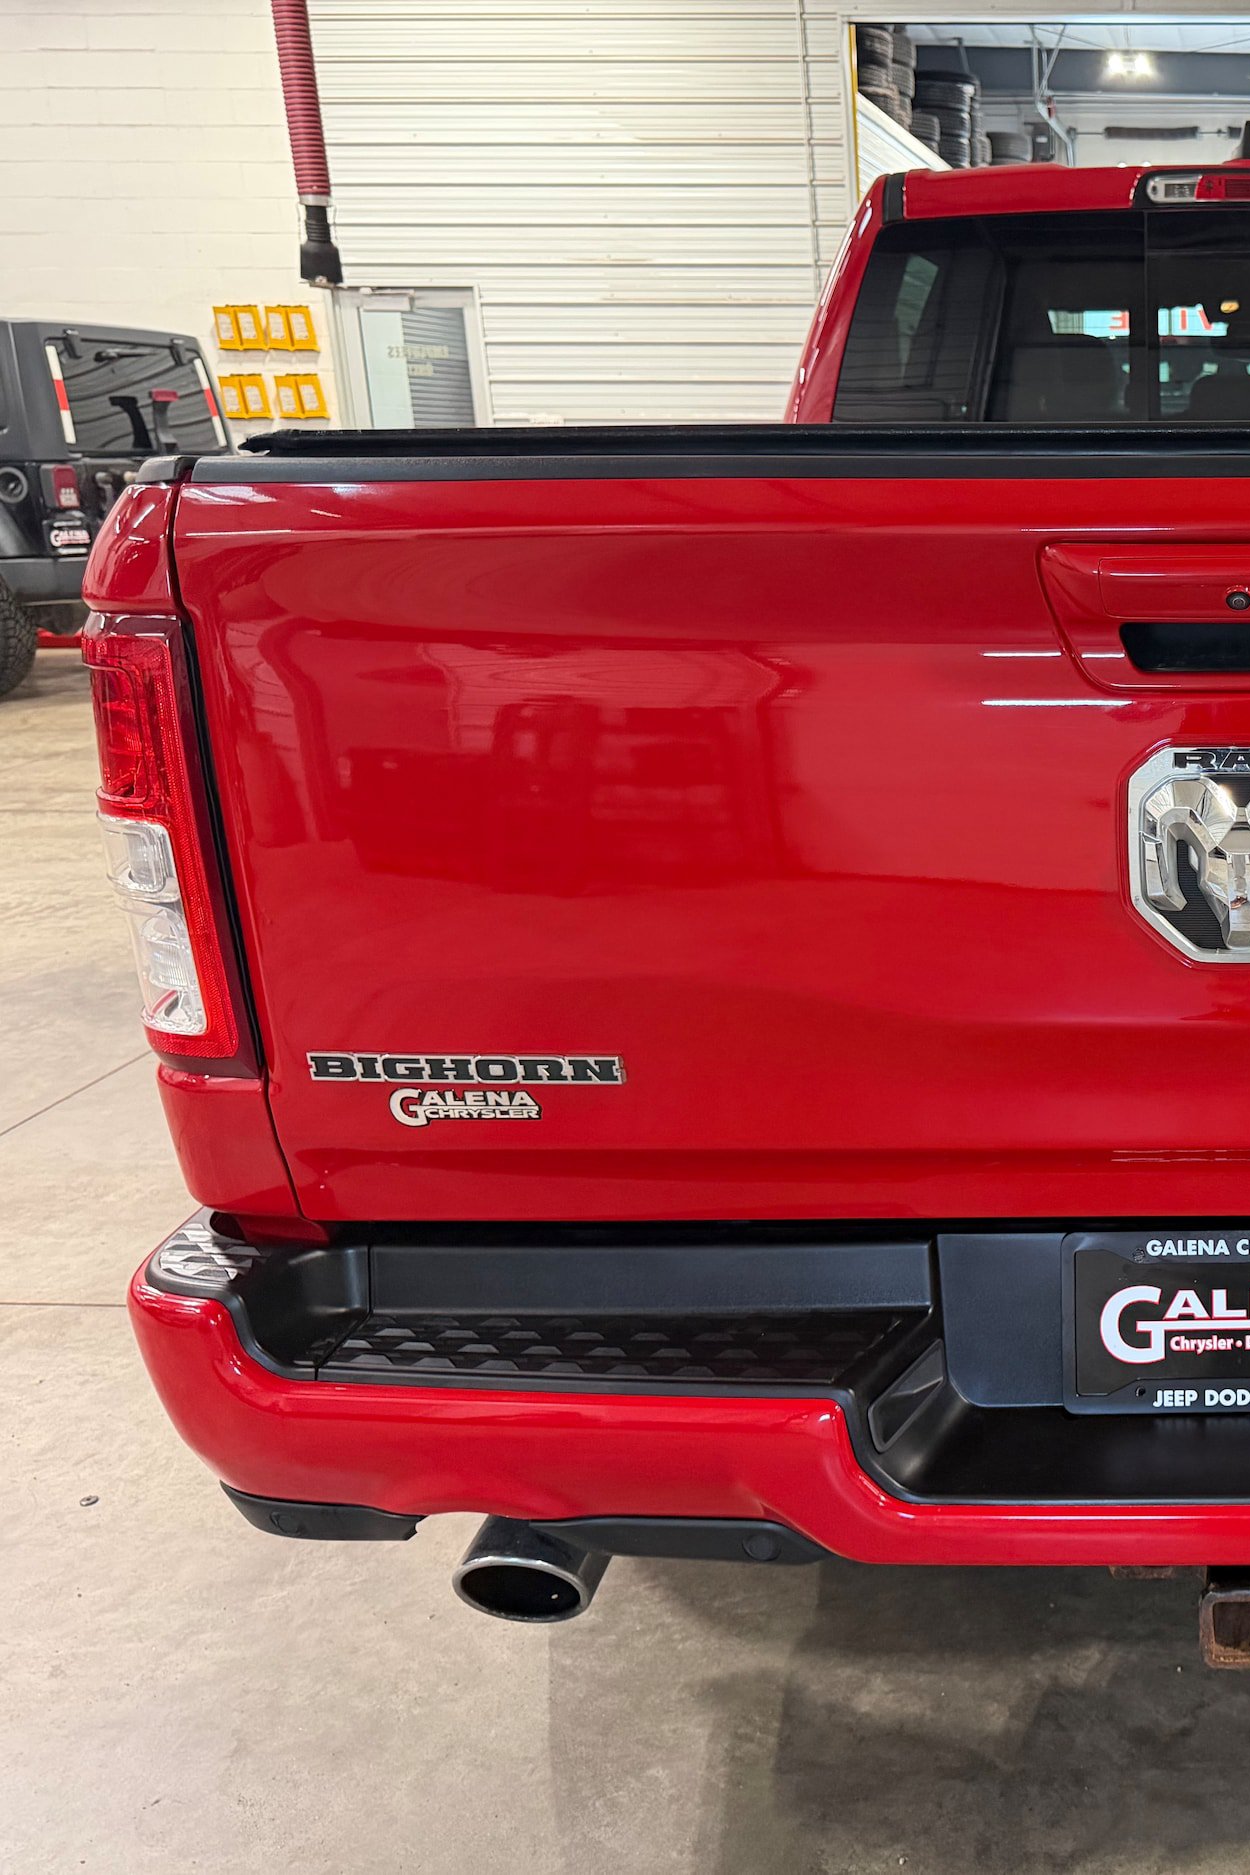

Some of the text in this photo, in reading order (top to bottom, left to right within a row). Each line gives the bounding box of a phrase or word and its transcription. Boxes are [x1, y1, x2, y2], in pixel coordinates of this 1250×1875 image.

[306, 1052, 625, 1085] BIGHORN
[389, 1088, 540, 1127] GALENA
[424, 1108, 541, 1120] CHRYSLER
[1146, 1239, 1230, 1257] GALENA
[1169, 1335, 1234, 1354] Chrysler
[1153, 1389, 1198, 1407] JEEP
